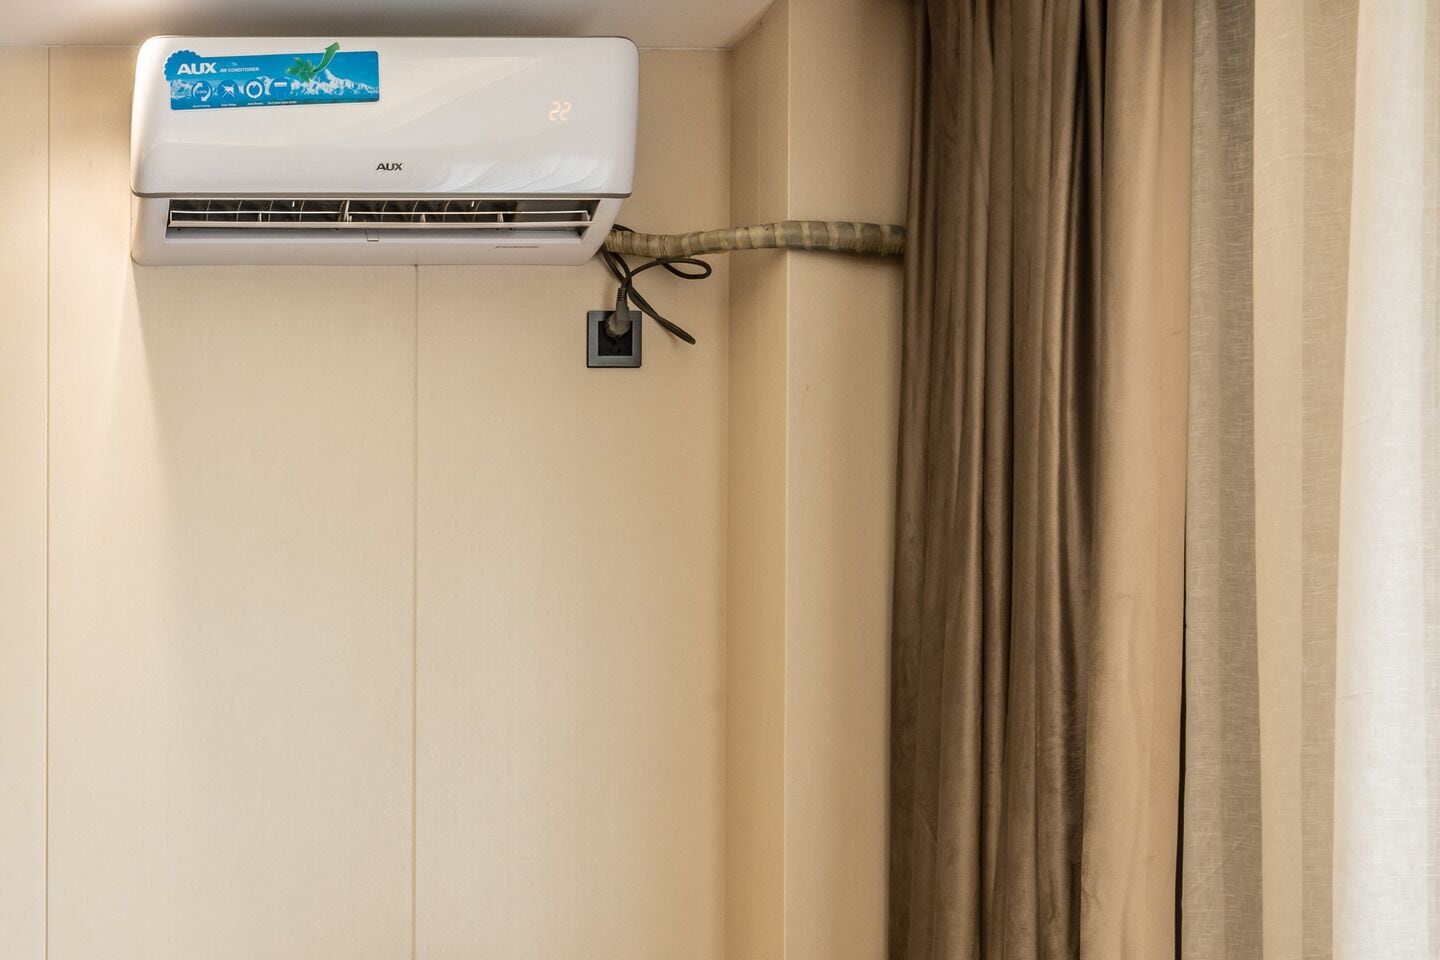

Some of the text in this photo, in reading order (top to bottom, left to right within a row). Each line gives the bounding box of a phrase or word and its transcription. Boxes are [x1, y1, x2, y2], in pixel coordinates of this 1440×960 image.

[177, 62, 217, 75] AUX
[549, 101, 572, 121] 22
[376, 163, 403, 171] AUX
